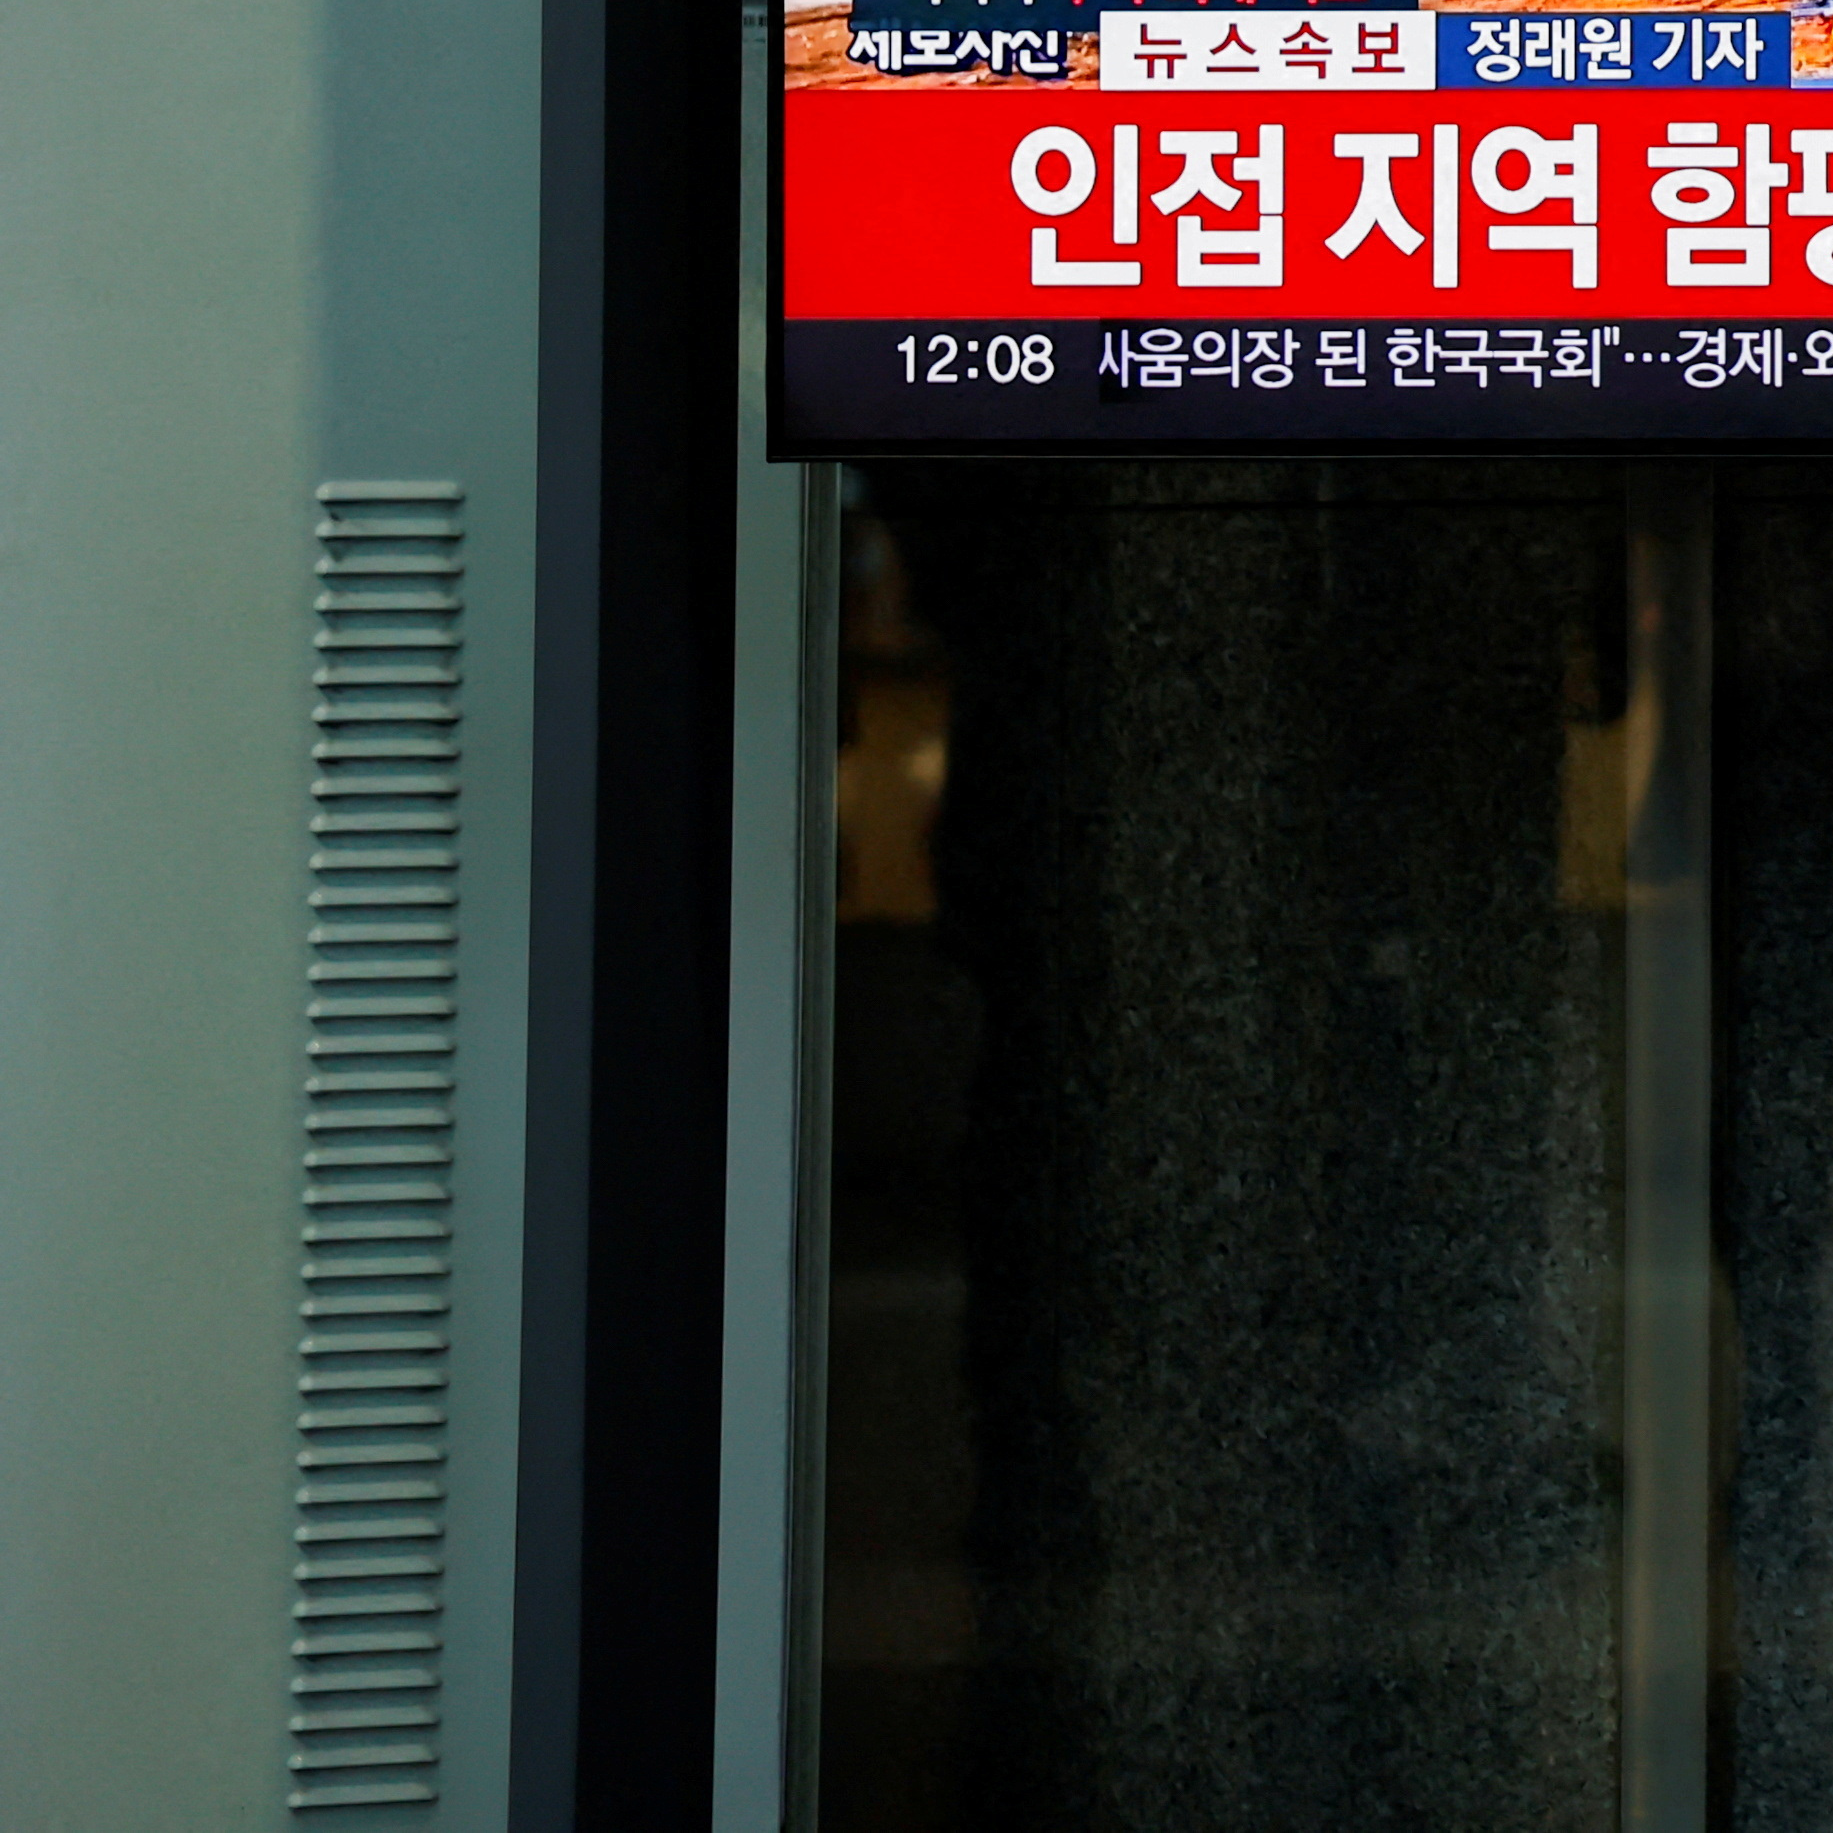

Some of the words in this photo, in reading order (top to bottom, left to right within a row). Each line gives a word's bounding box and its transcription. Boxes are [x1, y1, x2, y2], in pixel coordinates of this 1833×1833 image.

[1134, 22, 1405, 79] 뉴스속보
[1468, 18, 1631, 81] 정래원
[1653, 19, 1763, 80] 기자
[1012, 125, 1283, 286] 인접
[1325, 125, 1597, 288] 지역
[898, 335, 1054, 383] 12:08
[1316, 329, 1366, 386] 된
